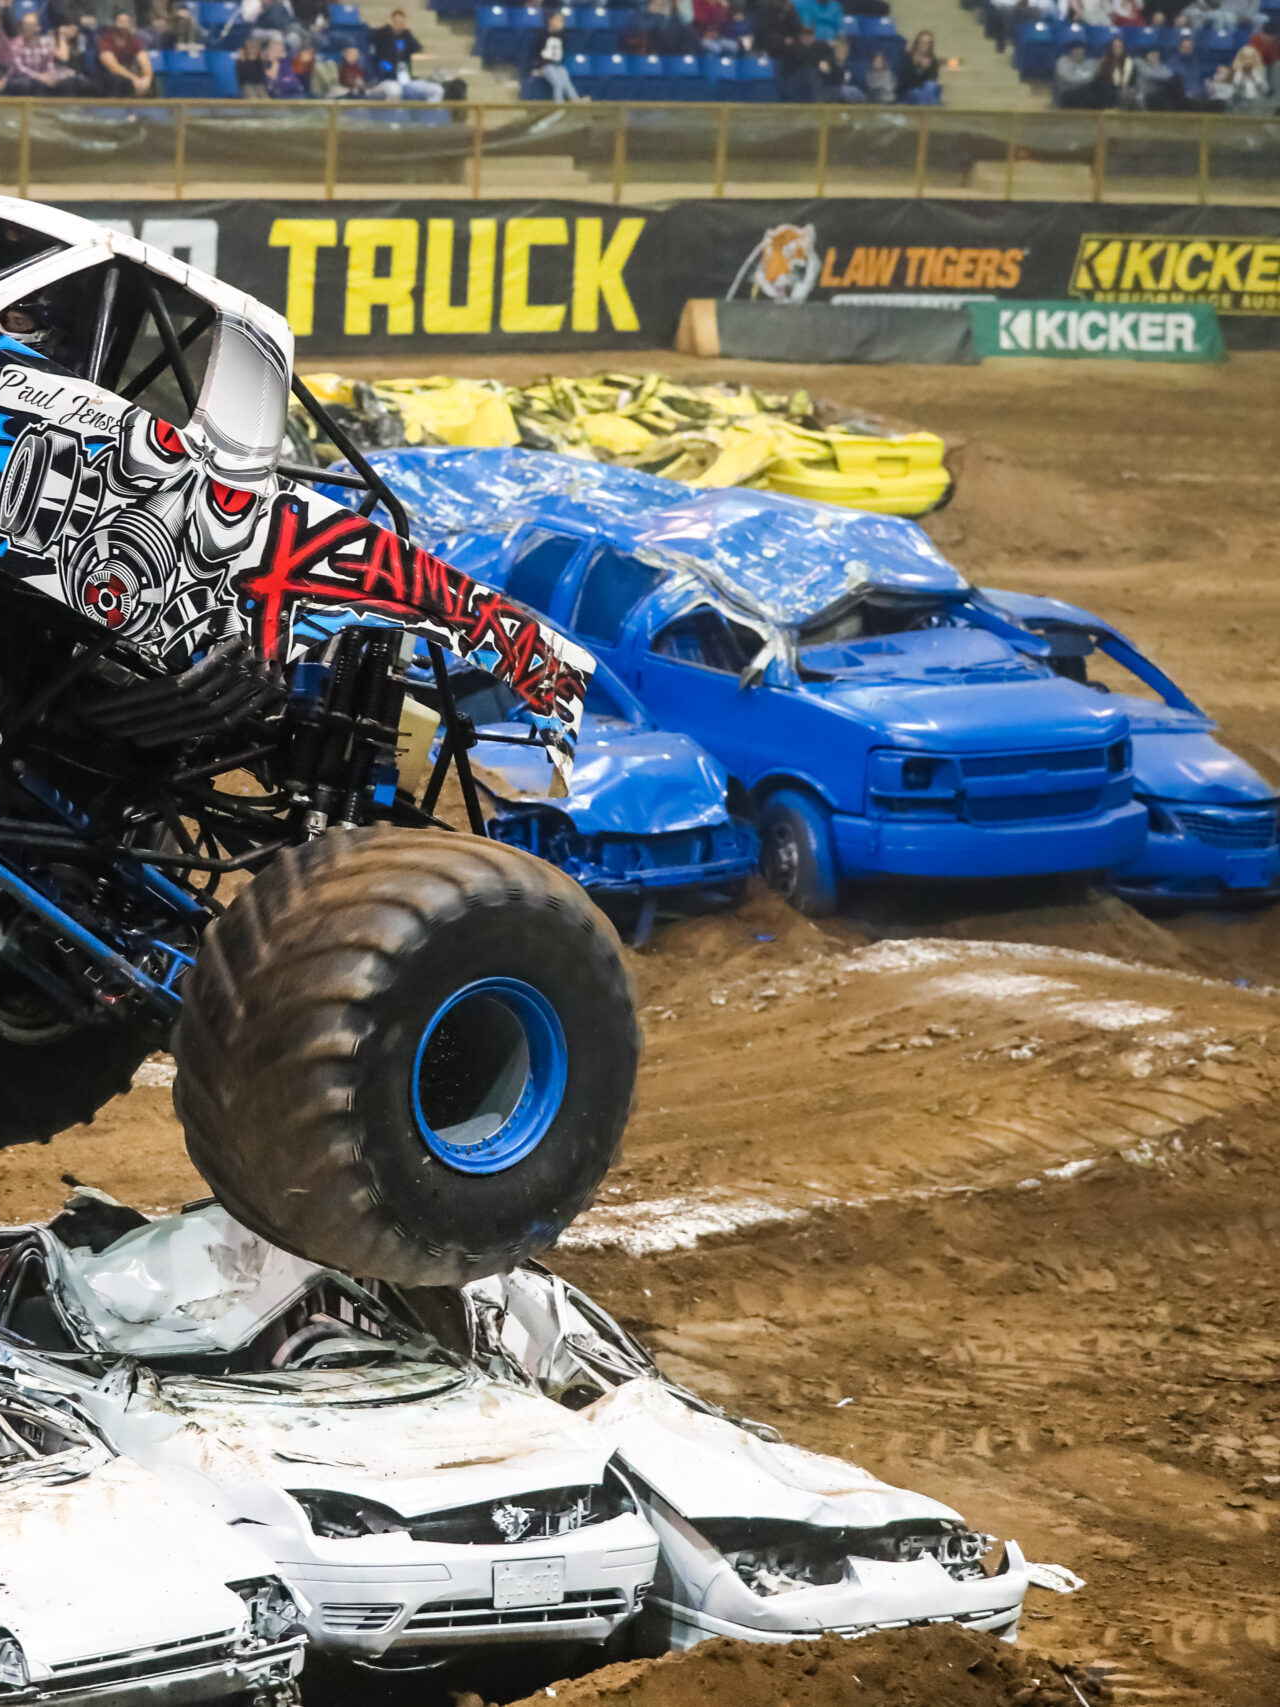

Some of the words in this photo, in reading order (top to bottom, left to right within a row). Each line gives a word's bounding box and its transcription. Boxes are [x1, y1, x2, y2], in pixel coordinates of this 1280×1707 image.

[268, 217, 646, 335] TRUCK
[820, 247, 901, 287] LAW
[904, 246, 1024, 288] TIGERS
[1120, 240, 1280, 292] KICKE
[1035, 309, 1197, 352] KICKER
